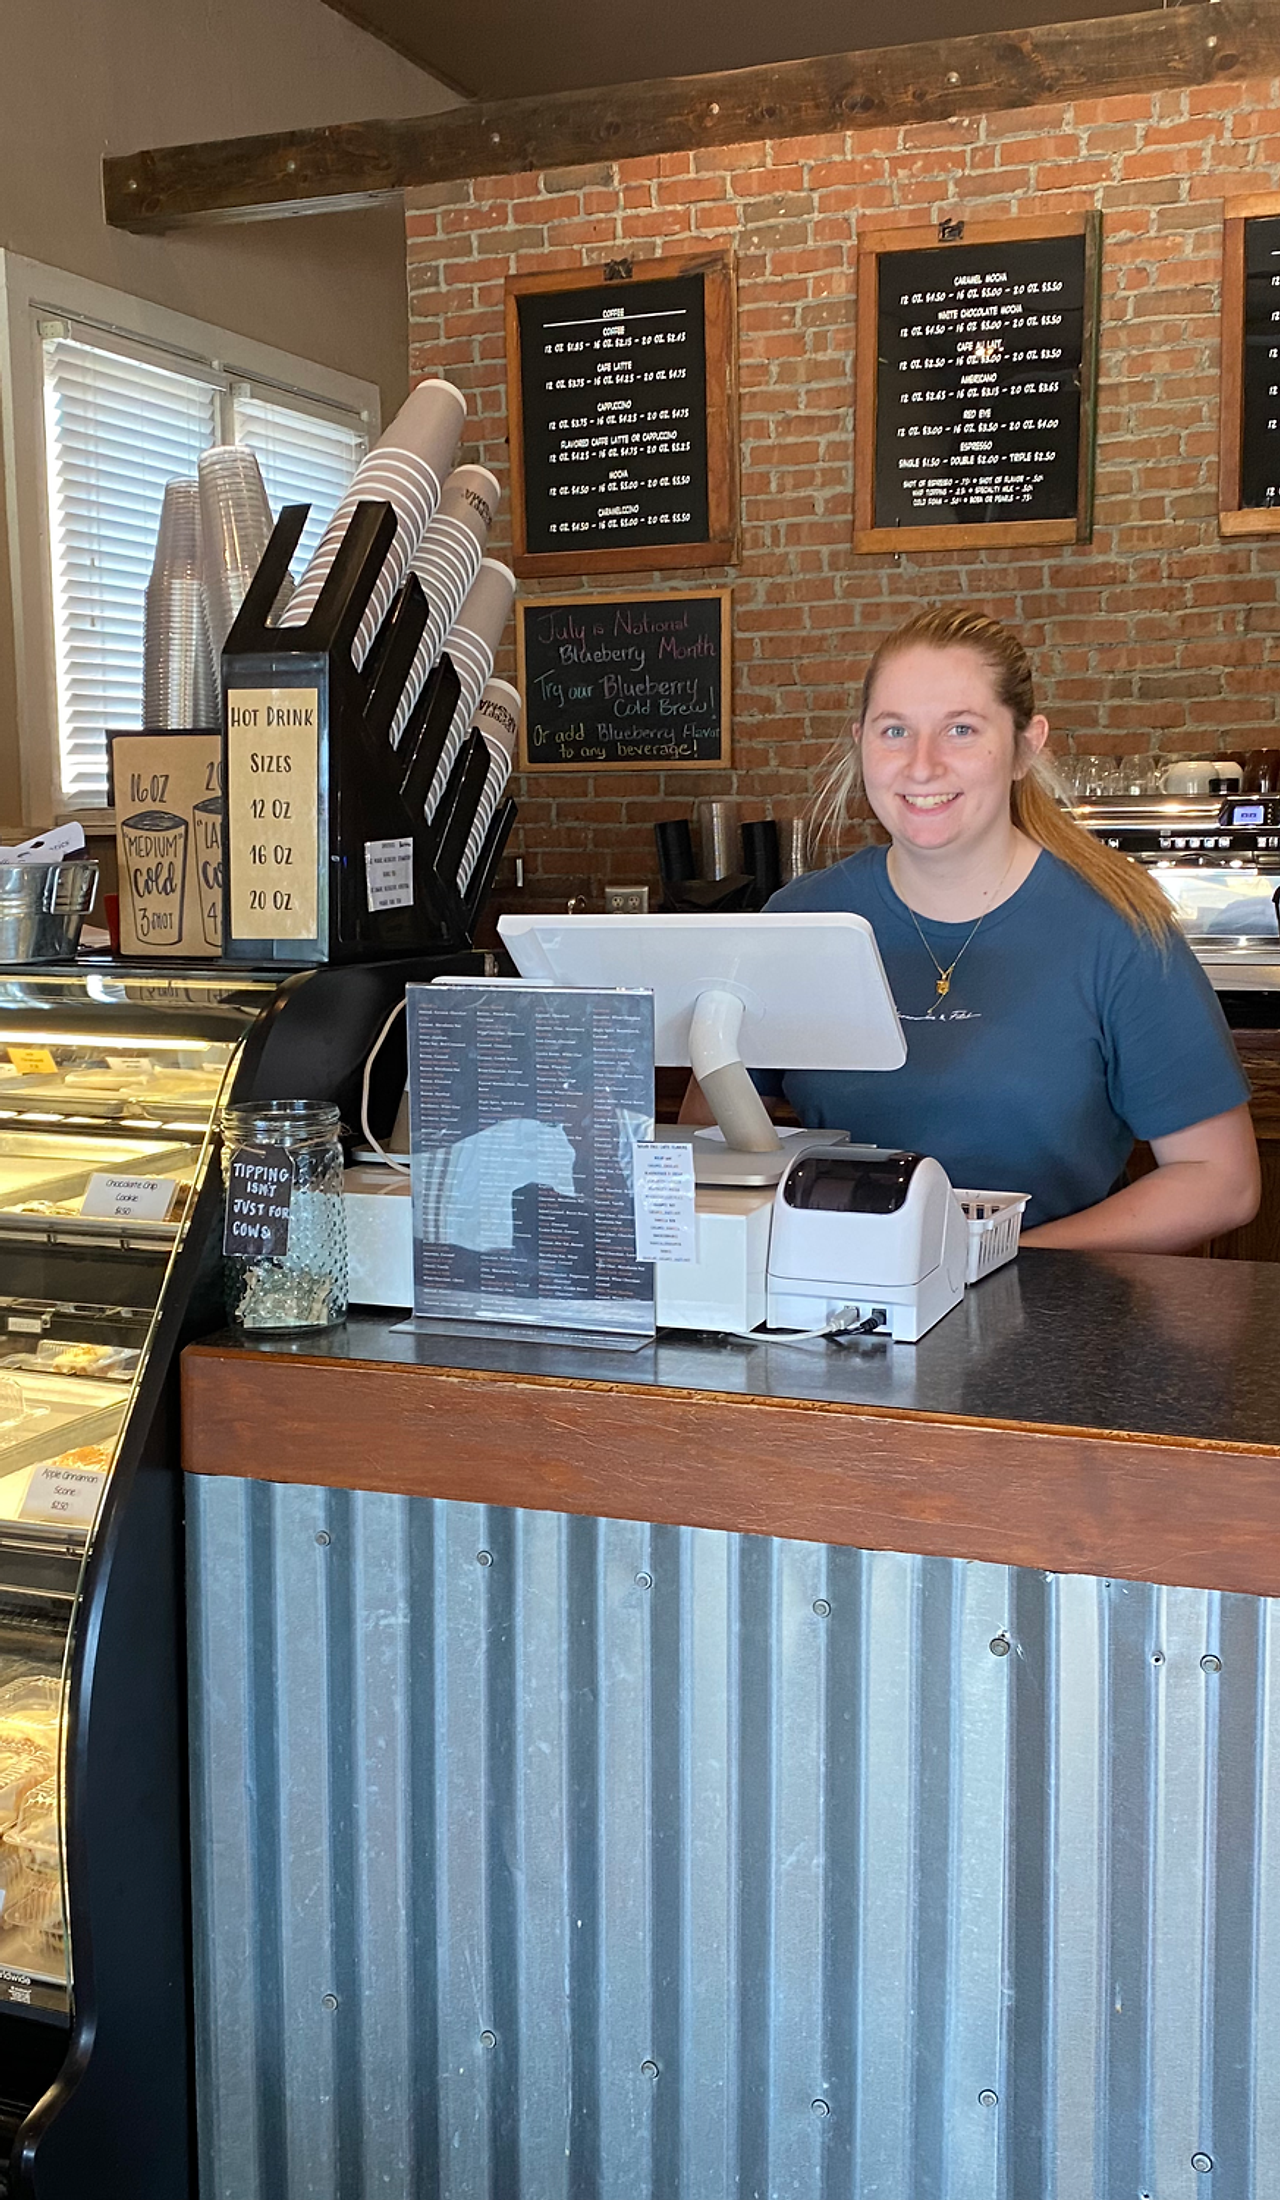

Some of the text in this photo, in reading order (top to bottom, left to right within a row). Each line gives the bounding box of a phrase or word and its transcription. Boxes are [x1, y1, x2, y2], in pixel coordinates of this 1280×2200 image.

[953, 272, 1008, 287] CARAMEL MOCHA
[900, 294, 910, 306] 12
[956, 289, 965, 301] 16
[1013, 284, 1025, 296] 20
[602, 308, 624, 318] COFFEE
[937, 304, 1023, 320] WHITE CHOCOLATE MOCHA
[602, 325, 625, 337] COFFEE
[900, 328, 909, 338] 12
[955, 322, 965, 333] 16
[1012, 318, 1025, 329] 20
[544, 344, 553, 354] 12
[641, 335, 653, 346] 20
[613, 360, 632, 371] LATTE
[899, 361, 908, 371] 12
[955, 355, 965, 367] 16
[1012, 351, 1025, 362] 20
[545, 381, 553, 391] 12
[593, 375, 601, 386] 16
[643, 372, 654, 382] 20
[960, 372, 998, 385] AMERICANO
[900, 393, 909, 404] 12
[956, 388, 966, 399] 16
[1010, 385, 1022, 396] 20
[596, 399, 632, 412] CAPPUCCINO
[963, 408, 992, 420] RED EYE
[548, 421, 556, 431] 12
[596, 416, 604, 426] 16
[646, 411, 658, 421] 20
[897, 428, 906, 438] 12
[953, 423, 962, 434] 16
[1009, 421, 1021, 431] 20
[560, 438, 590, 450] FLAVORED
[610, 434, 629, 445] LATTE
[630, 433, 641, 443] OR
[642, 430, 678, 442] CAPPUCCINO
[960, 440, 993, 452] ESPRESSO
[549, 454, 557, 463] 12
[598, 449, 607, 459] 16
[646, 445, 657, 455] 20
[898, 457, 920, 469] SINGLE
[950, 454, 975, 466] DOUBLE
[1009, 451, 1032, 463] TRIPLE
[608, 469, 629, 480] MOCHA
[549, 487, 557, 497] 12
[598, 483, 606, 493] 16
[647, 478, 658, 489] 20
[549, 524, 557, 533] 12
[598, 520, 606, 530] 16
[647, 515, 658, 525] 20
[537, 608, 689, 654] July is National
[559, 634, 716, 671] Blueberry Month
[533, 669, 698, 708] Try our Blueberry
[614, 686, 717, 720] Cold Brew!
[533, 724, 550, 747] Or
[555, 722, 585, 743] add
[597, 723, 675, 745] Blueberry
[559, 739, 698, 760] to any beverage!
[250, 799, 265, 819] 12
[249, 844, 267, 865] 16
[250, 890, 267, 910] 20
[207, 901, 218, 935] 4
[233, 1163, 289, 1182] TIPPING
[105, 1179, 158, 1191] Chocolate Chip
[115, 1192, 139, 1202] Cookie
[233, 1199, 290, 1219] JUST FOR
[233, 1221, 271, 1240] COWS
[41, 1468, 98, 1483] Apple Cinnamon
[53, 1485, 76, 1497] Scone
